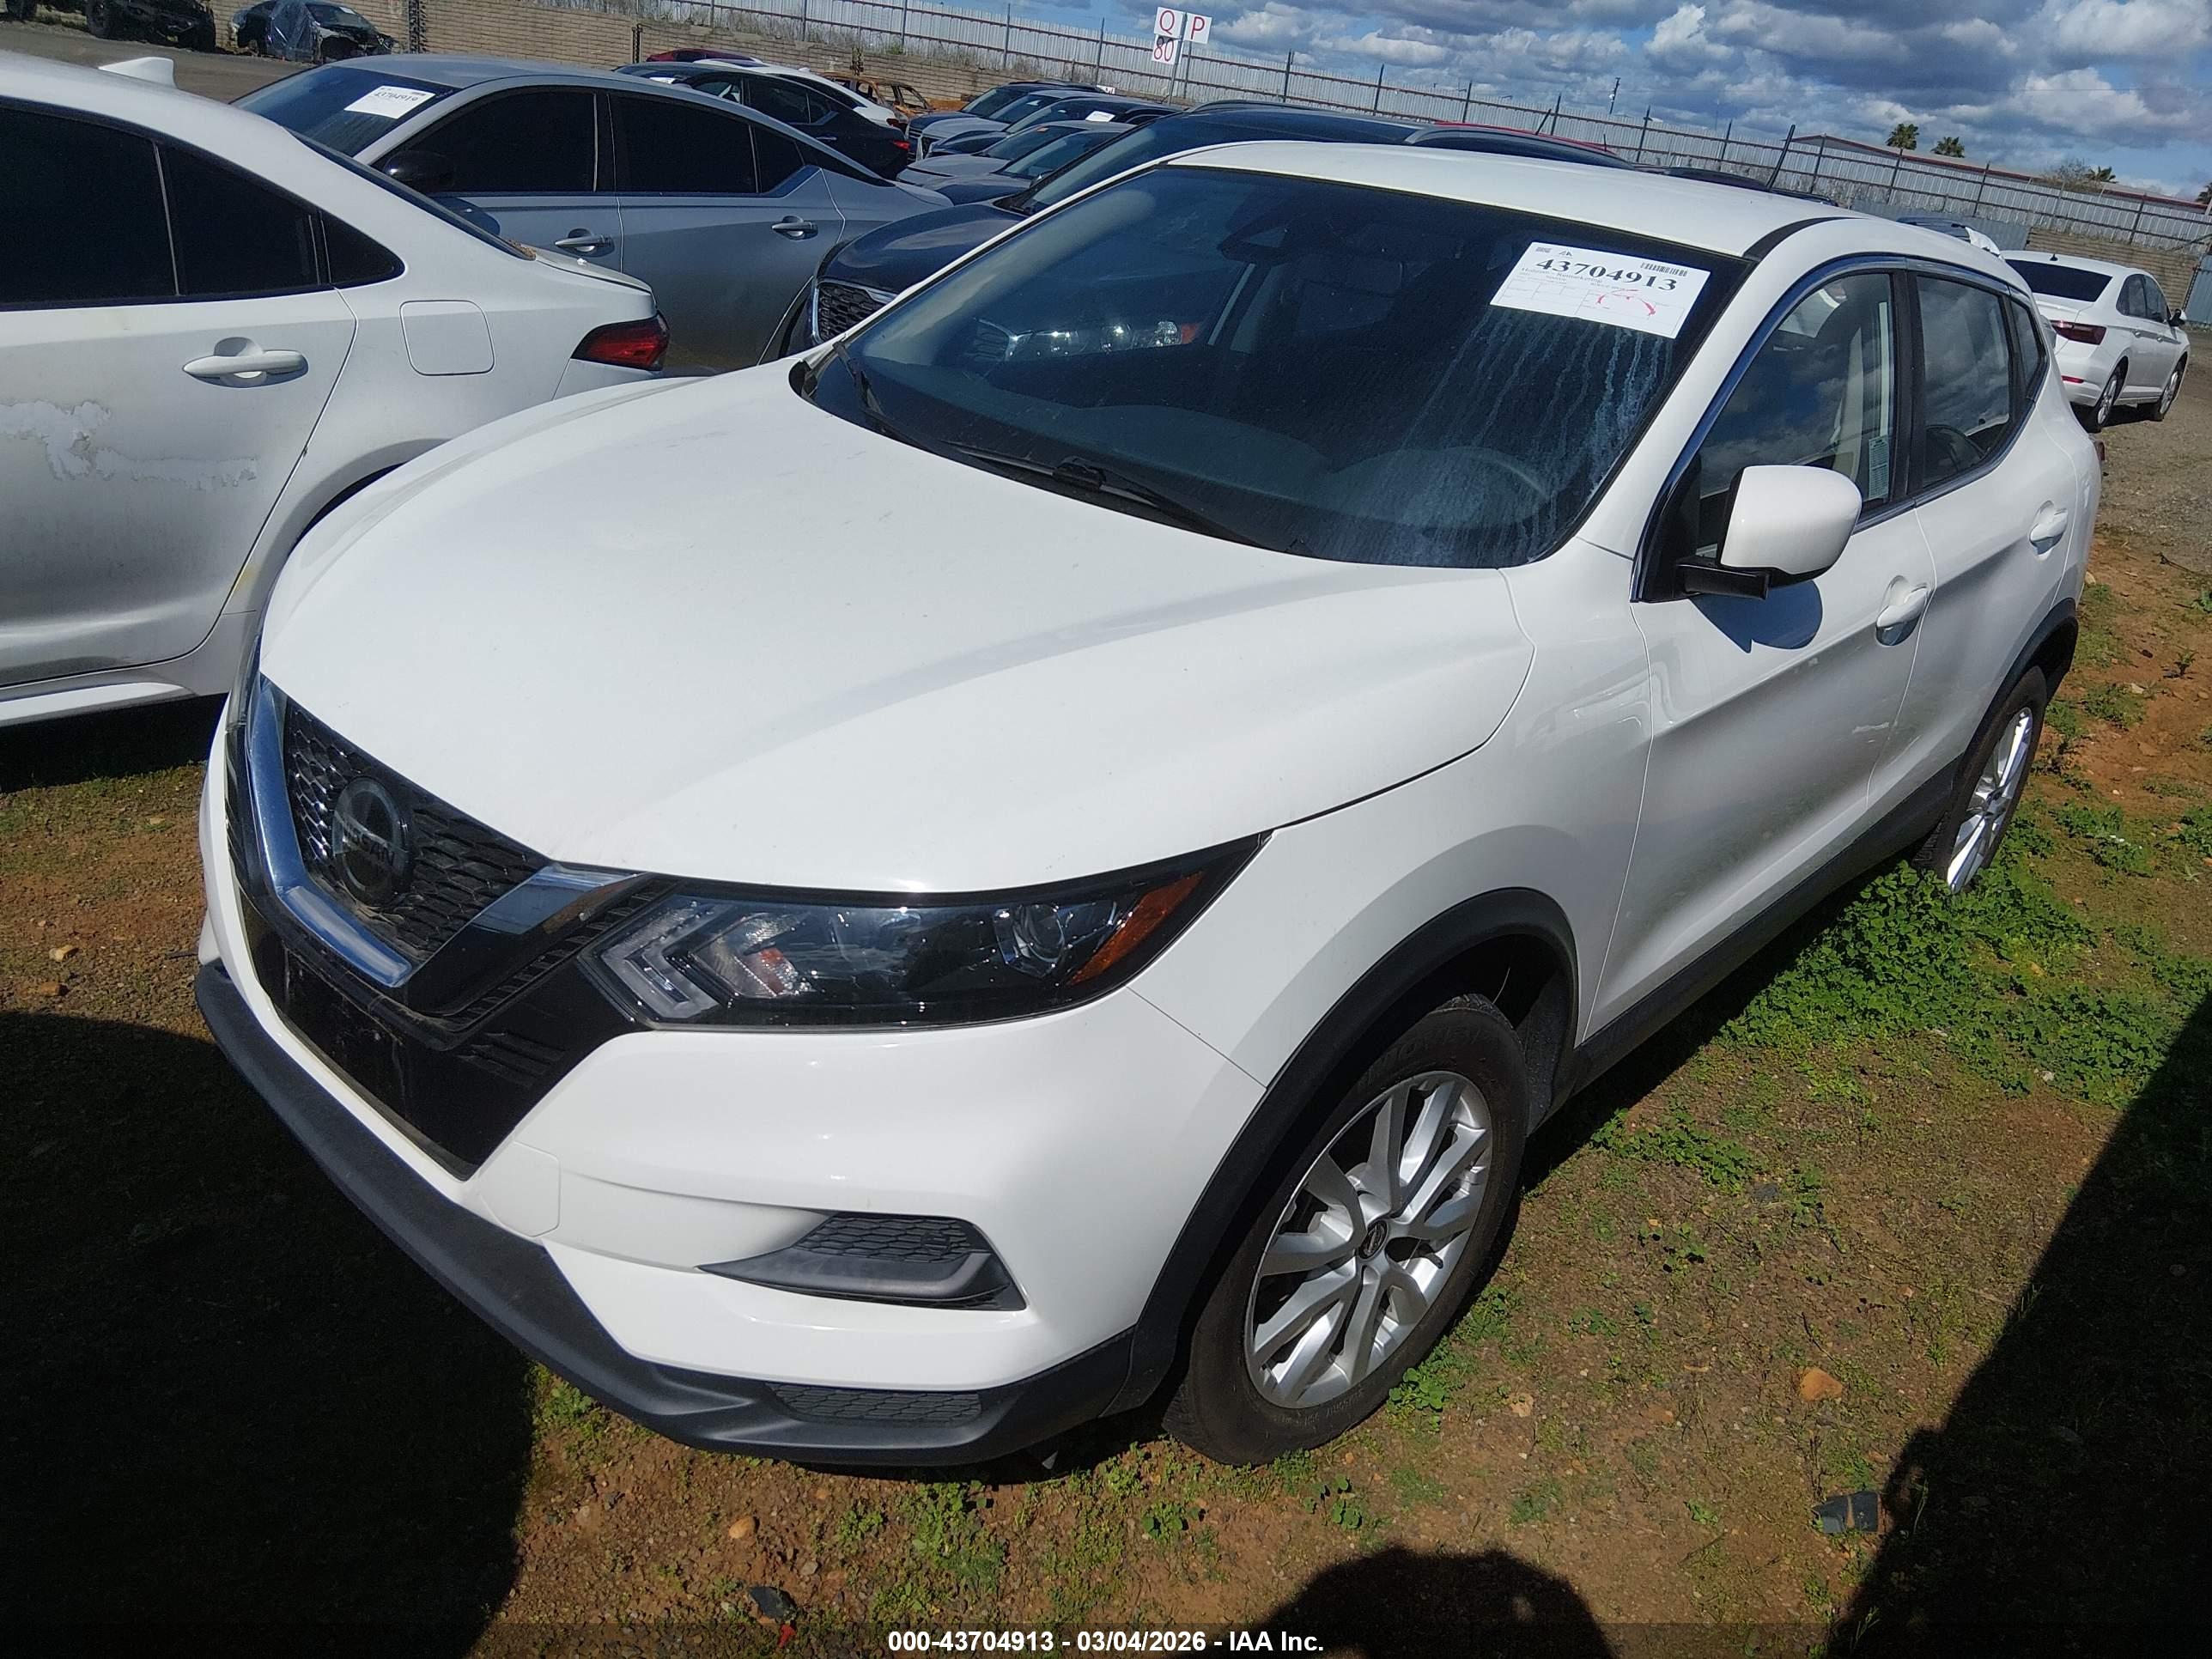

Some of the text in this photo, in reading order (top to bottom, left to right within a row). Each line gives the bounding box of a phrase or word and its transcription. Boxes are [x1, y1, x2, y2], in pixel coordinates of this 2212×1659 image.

[1159, 10, 1175, 35] Q
[1190, 16, 1206, 40] P
[1153, 36, 1174, 62] 80
[1535, 258, 1678, 291] 43704913
